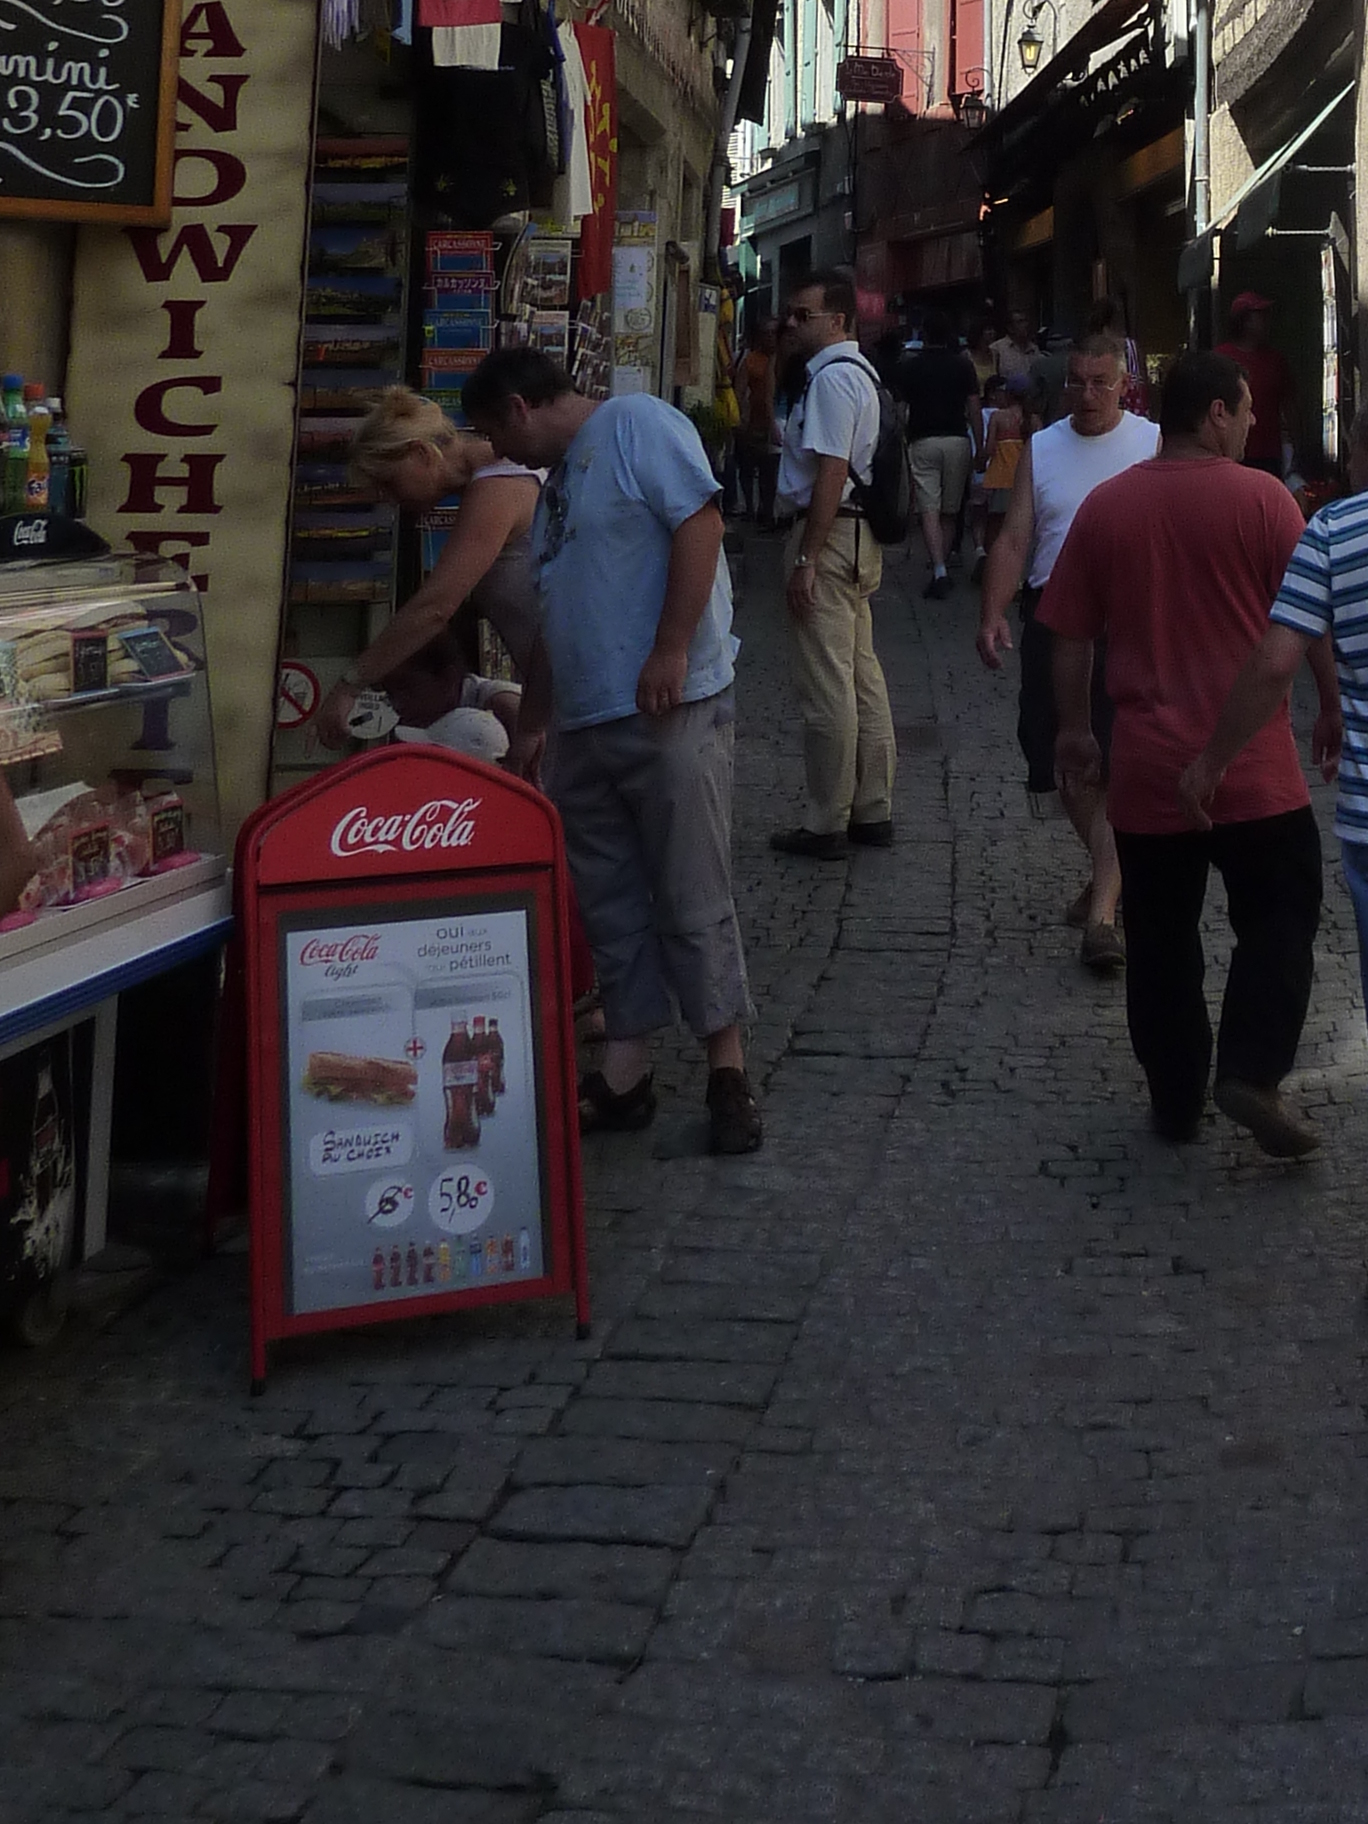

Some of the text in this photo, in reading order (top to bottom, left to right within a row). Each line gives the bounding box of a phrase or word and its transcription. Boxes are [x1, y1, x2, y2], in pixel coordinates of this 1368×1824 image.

[331, 797, 483, 858] Coca-Cola
[436, 926, 464, 941] oui
[300, 933, 382, 967] Coca-Cola
[417, 939, 492, 959] déjeuners
[324, 963, 359, 982] light
[449, 953, 512, 973] pétillent
[322, 1130, 401, 1152] SANDWICH
[345, 1145, 393, 1163] CHOIX
